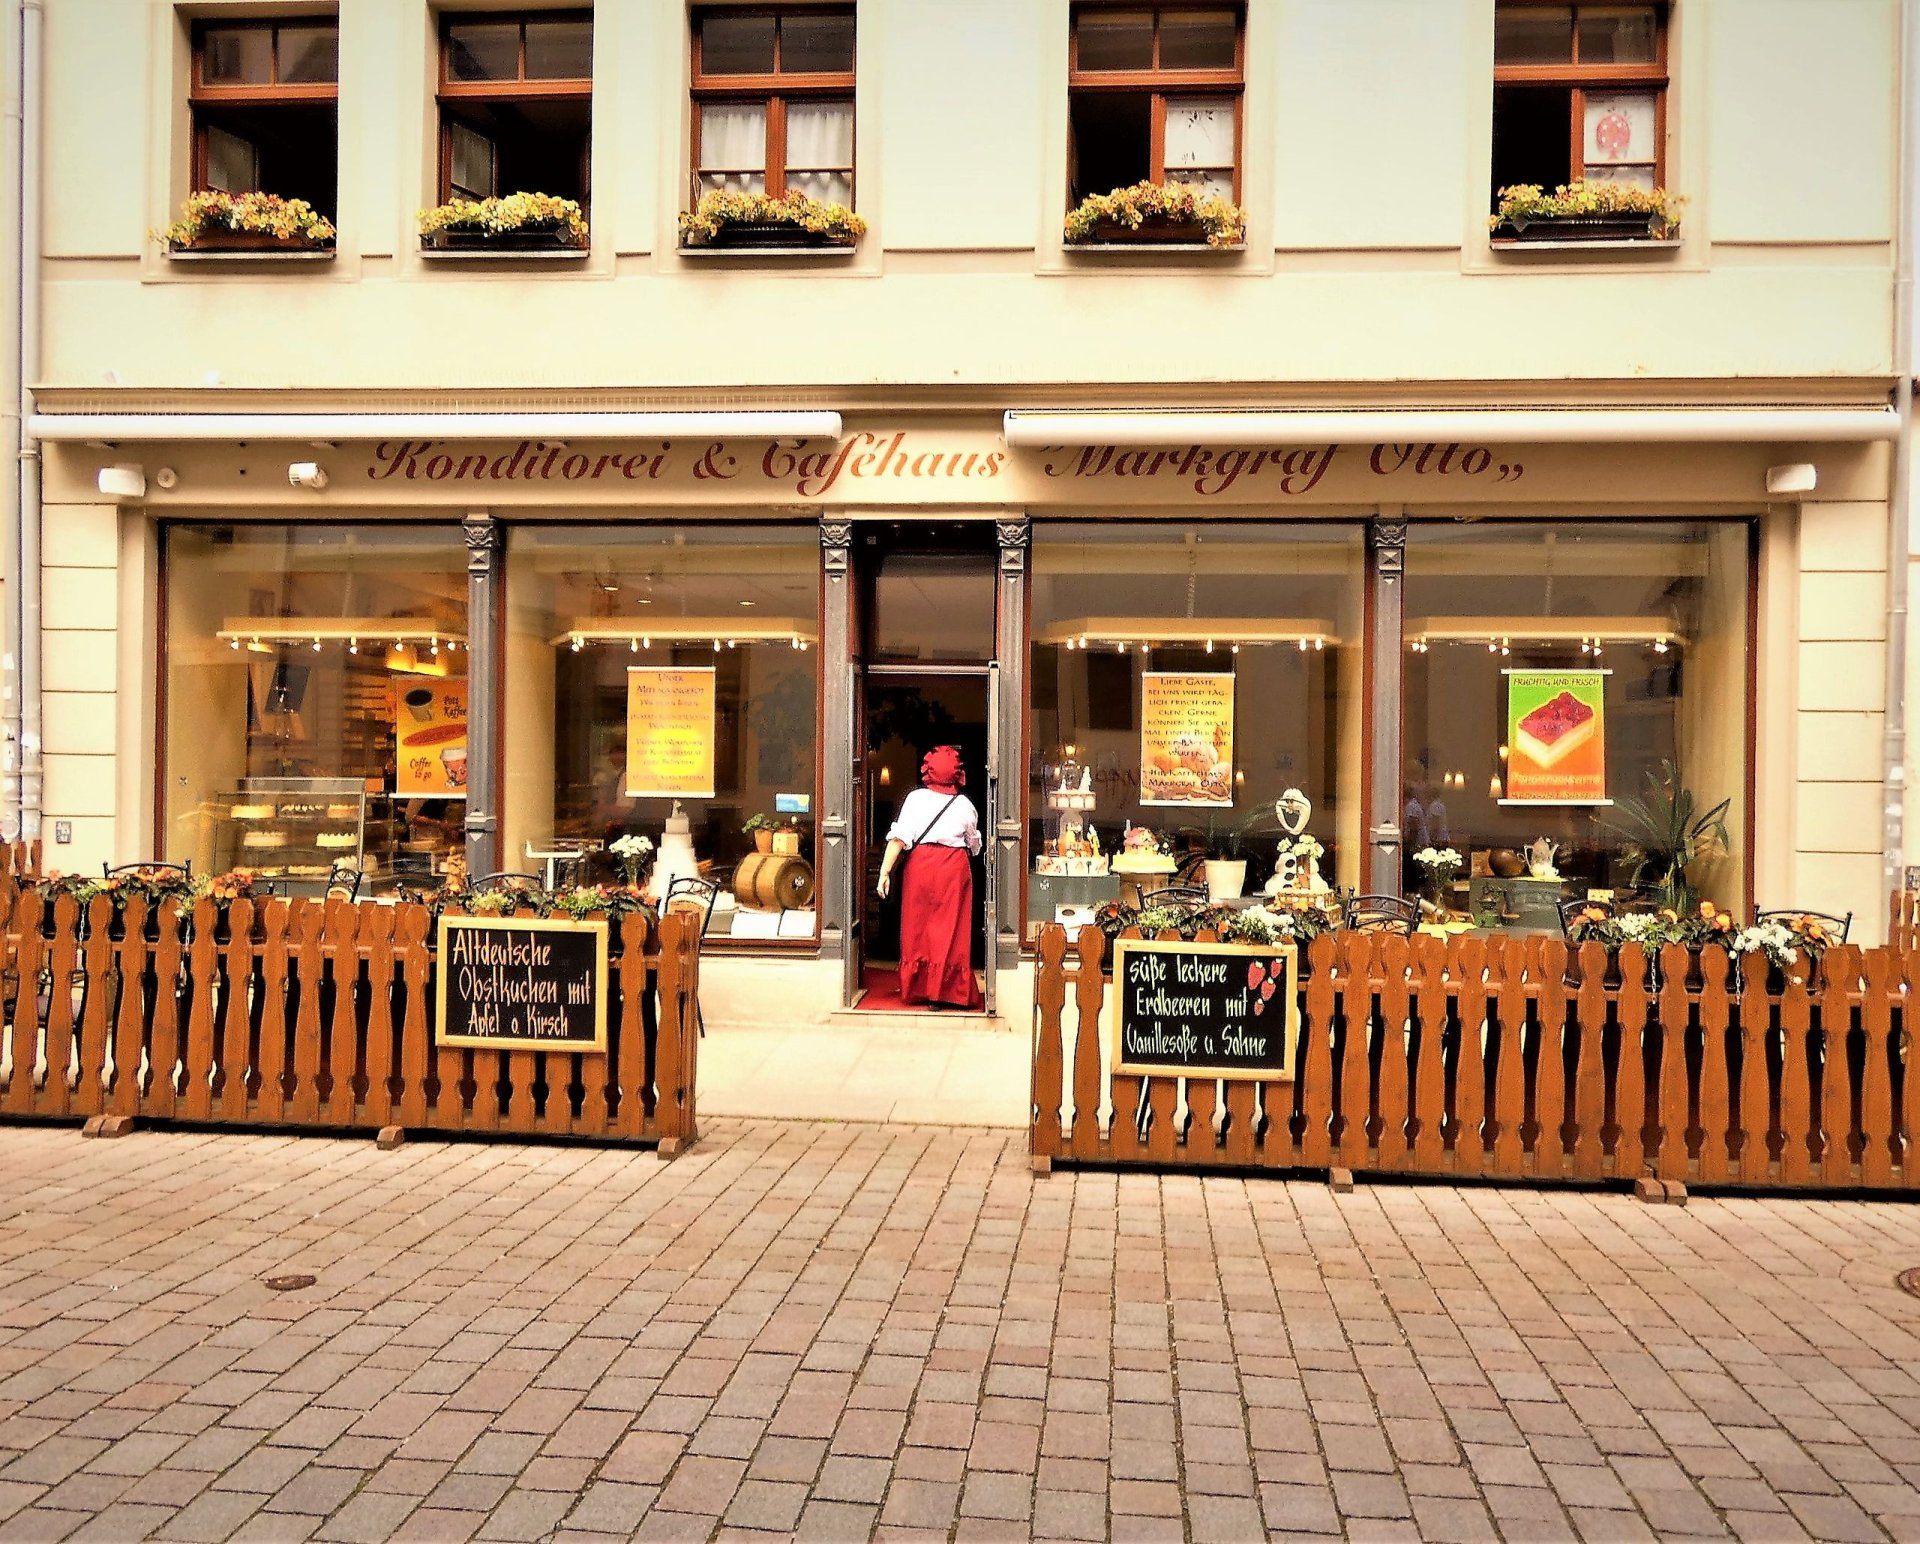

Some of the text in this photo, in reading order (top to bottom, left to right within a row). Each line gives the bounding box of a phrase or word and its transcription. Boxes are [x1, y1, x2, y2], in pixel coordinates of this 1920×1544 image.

[368, 440, 671, 480] Konditorei
[692, 441, 742, 480] &
[762, 432, 1008, 497] Caféhaus
[1553, 678, 1569, 686] UND
[1572, 677, 1600, 686] FRISCH
[453, 929, 551, 966] Altdeutsche
[459, 965, 591, 1007] Obstkuchen mit
[1129, 953, 1228, 990] süße leckere
[1136, 986, 1248, 1017] Erdbeeren mit
[467, 1002, 500, 1037] Apfel
[527, 1004, 568, 1039] Kirsch
[1126, 1021, 1267, 1062] Vanillesoße u. Sahne
